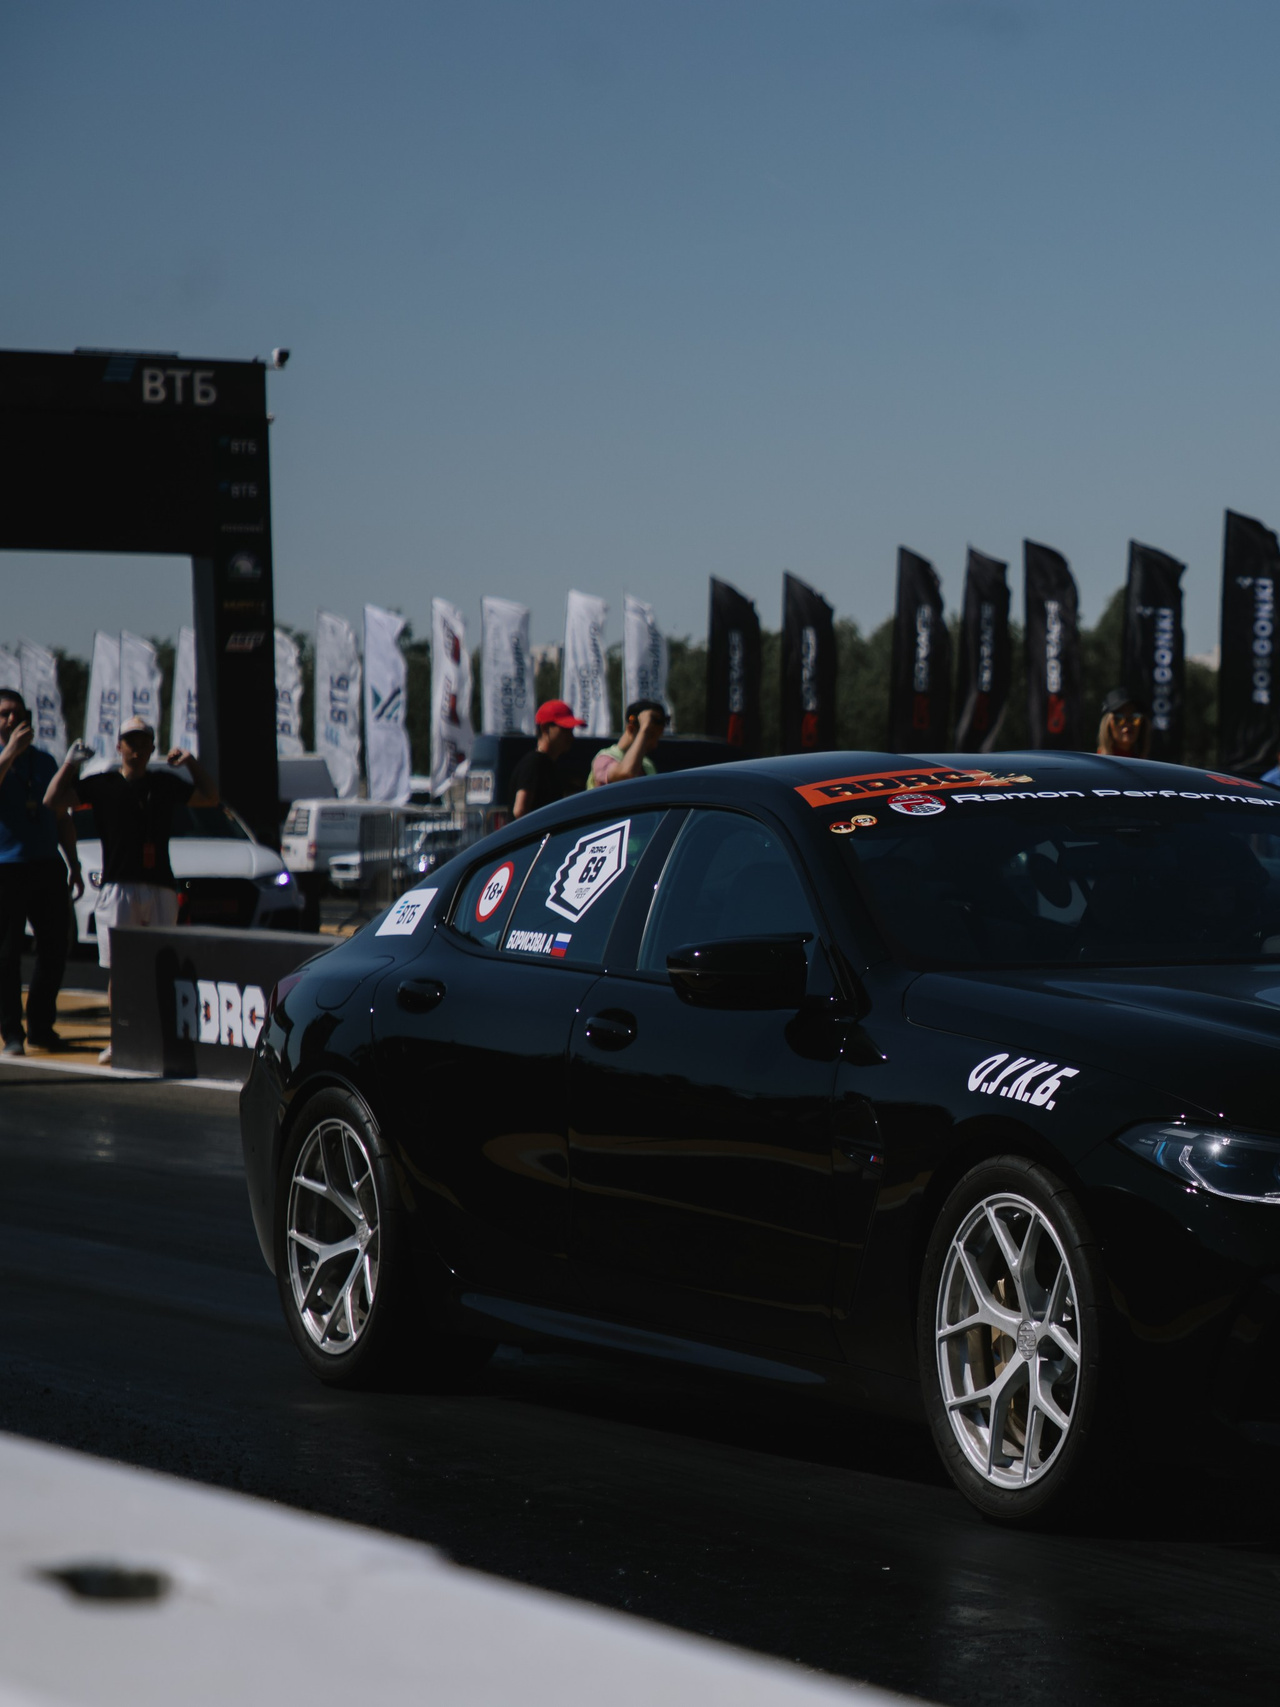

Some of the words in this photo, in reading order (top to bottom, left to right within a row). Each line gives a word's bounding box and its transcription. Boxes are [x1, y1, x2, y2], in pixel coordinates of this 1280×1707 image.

[142, 366, 218, 407] ВТБ
[950, 789, 1085, 805] Ramon
[578, 856, 607, 883] 69
[484, 882, 503, 901] 18+
[396, 904, 421, 925] ВТБ
[505, 929, 548, 953] БОРИСОВА
[173, 976, 267, 1050] RDRC
